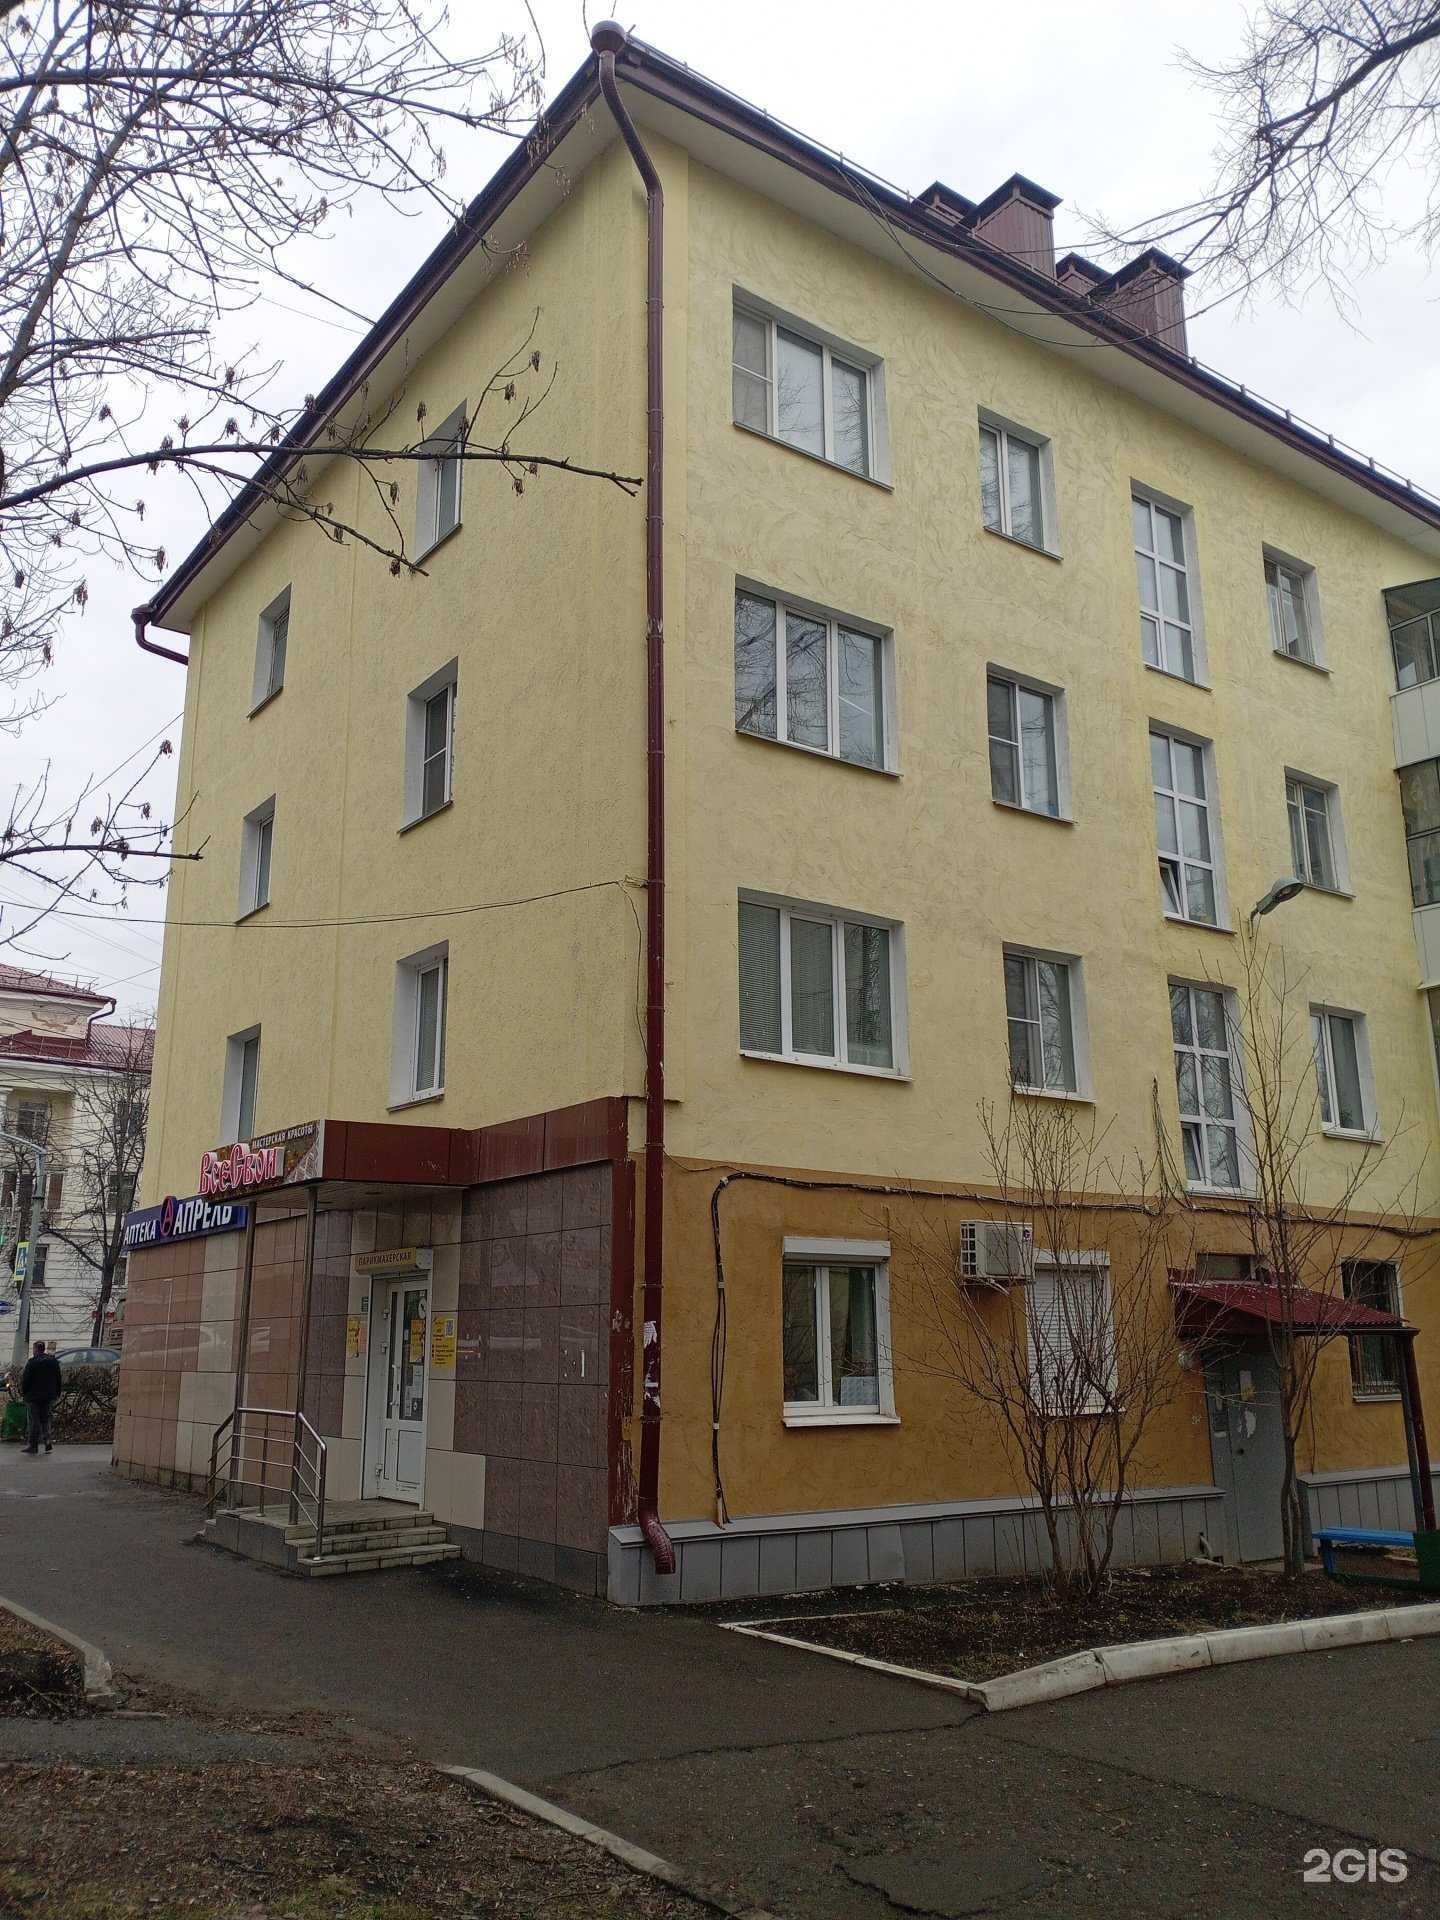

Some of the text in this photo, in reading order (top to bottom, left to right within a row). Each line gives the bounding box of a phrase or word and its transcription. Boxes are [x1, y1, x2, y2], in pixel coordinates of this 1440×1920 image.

[288, 1125, 313, 1139] КРАСОТЫ
[123, 1220, 156, 1246] АПТЕКА
[173, 1199, 232, 1235] АПРЕЛЬ
